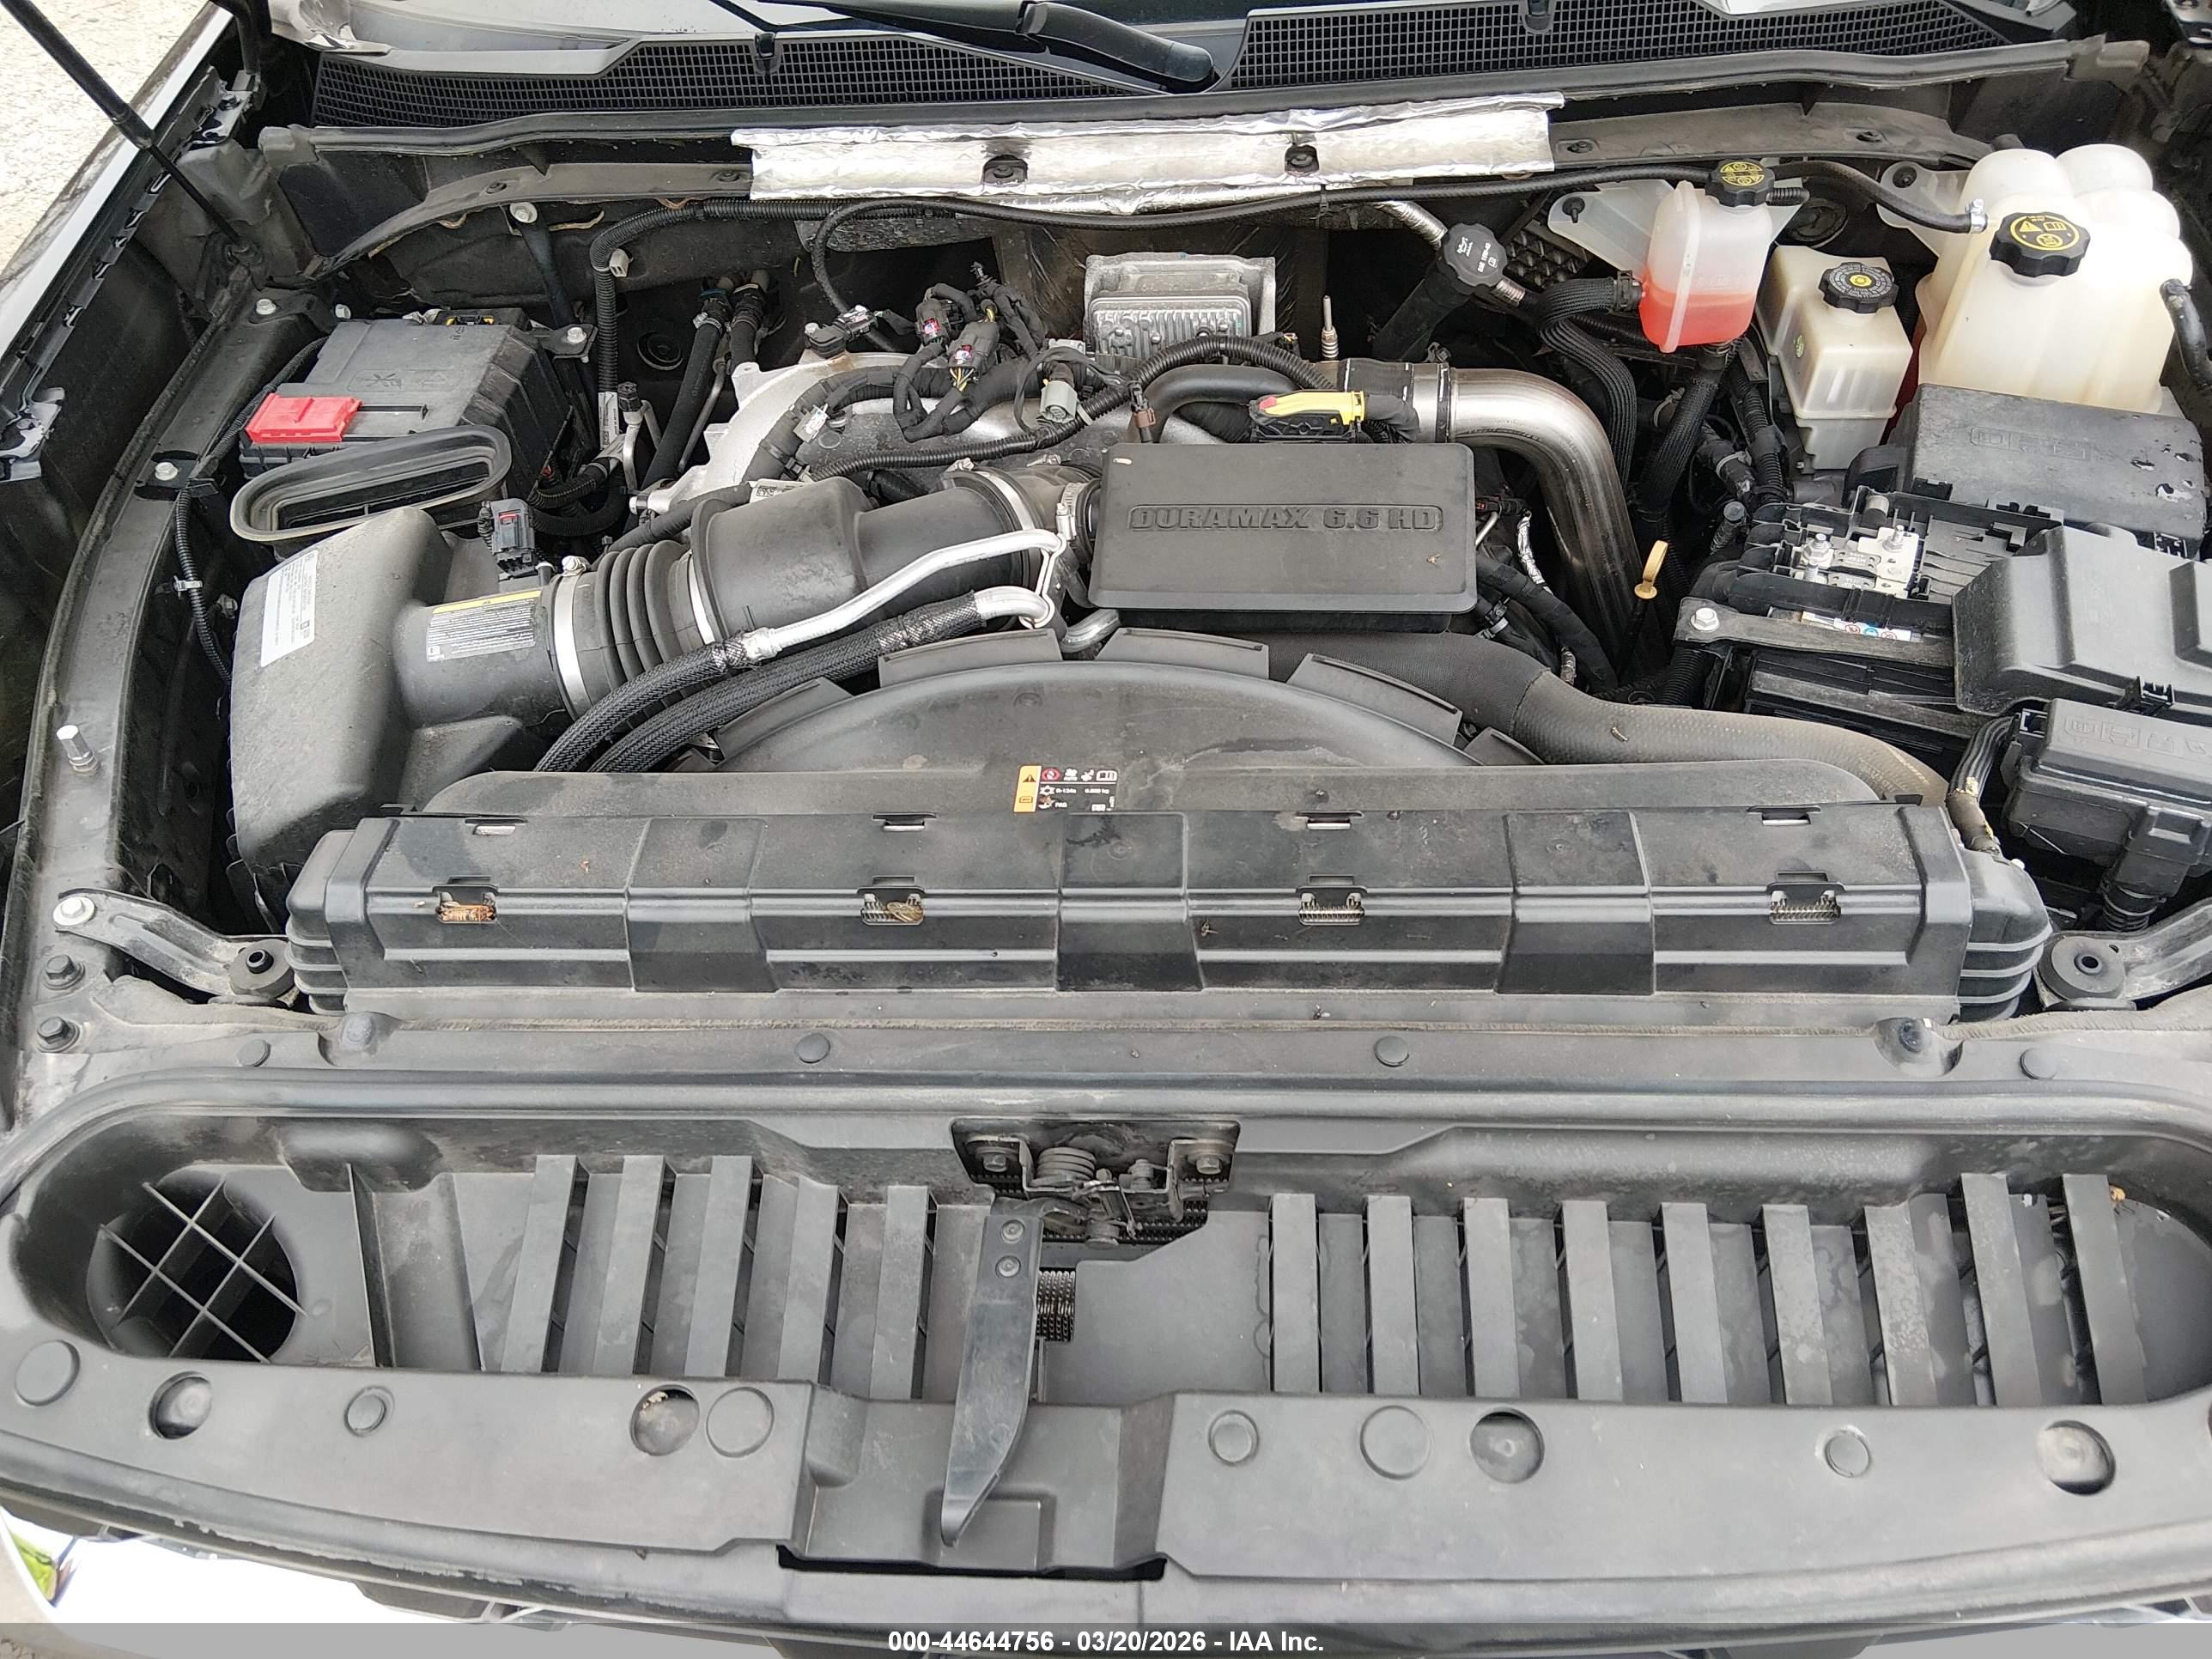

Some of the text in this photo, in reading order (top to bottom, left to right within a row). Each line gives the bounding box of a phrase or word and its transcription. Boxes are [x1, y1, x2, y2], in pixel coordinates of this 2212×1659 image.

[1132, 507, 1439, 531] DURAMAX 6.6 HD
